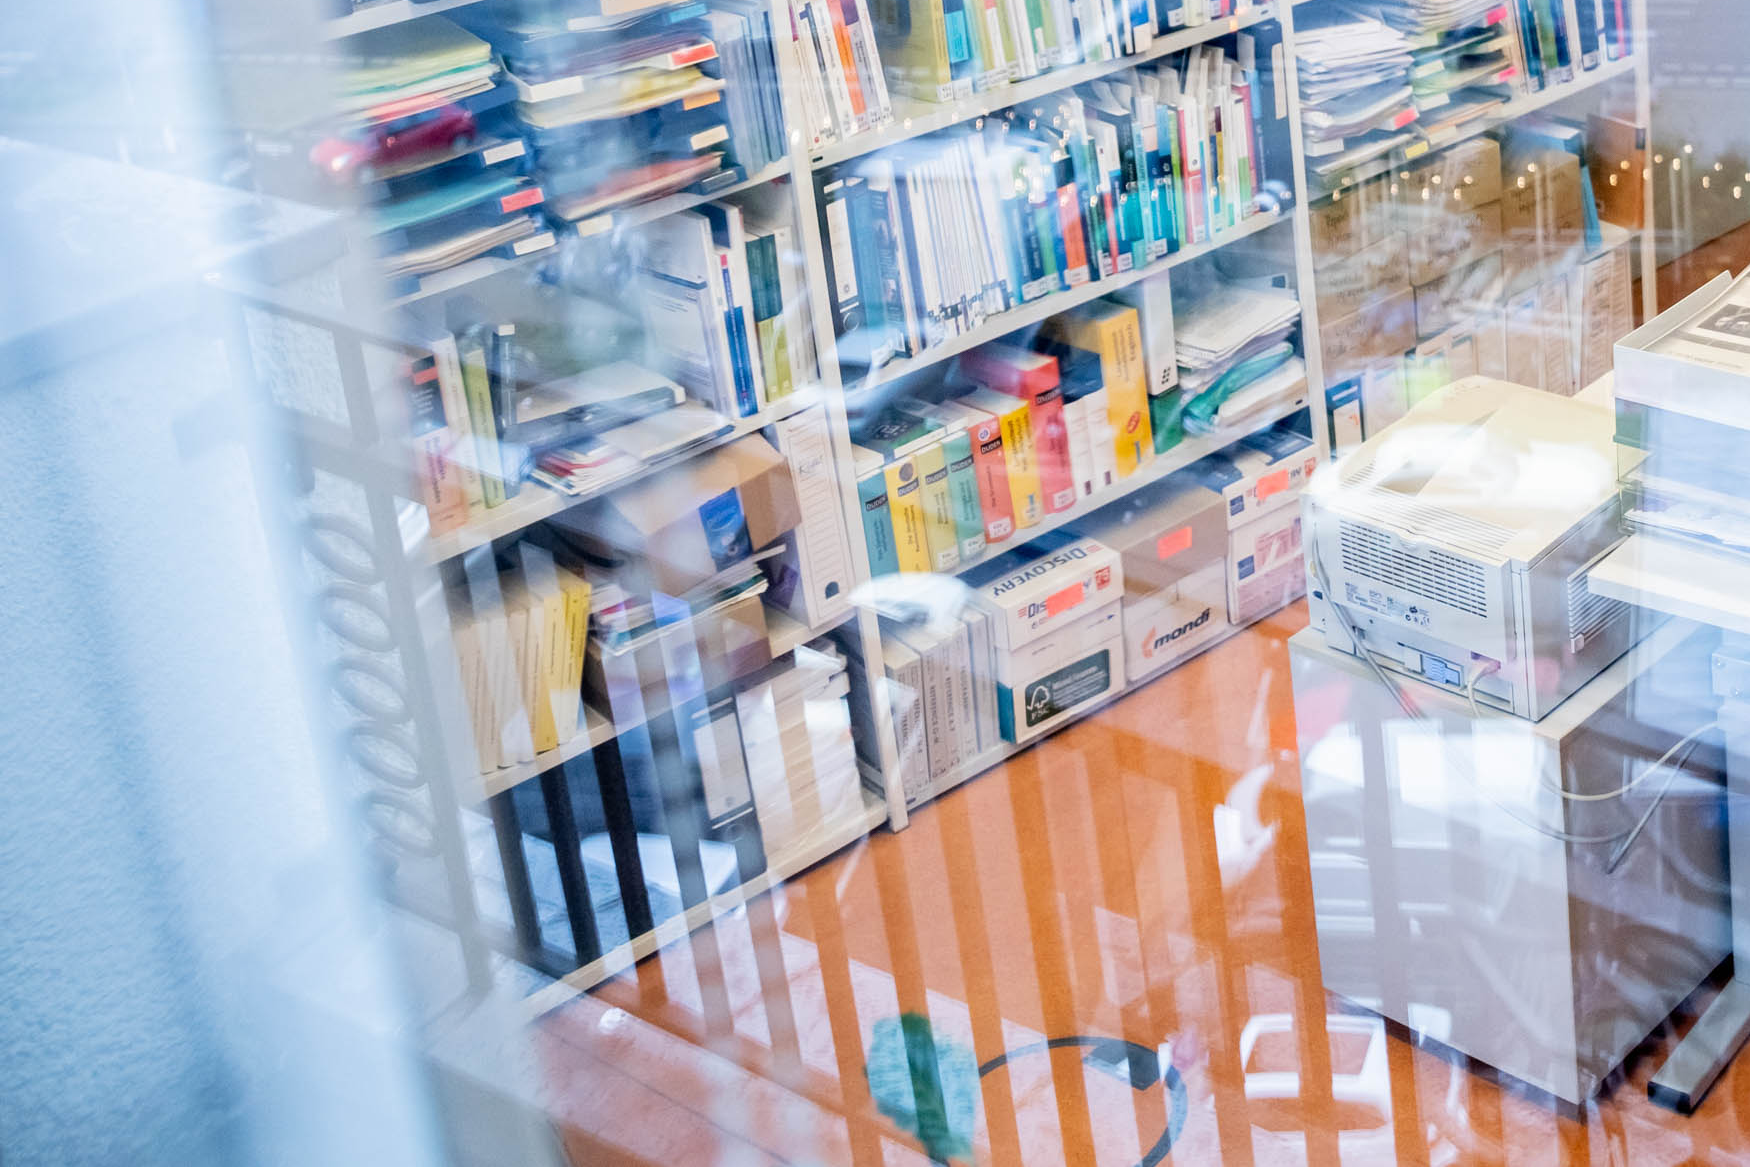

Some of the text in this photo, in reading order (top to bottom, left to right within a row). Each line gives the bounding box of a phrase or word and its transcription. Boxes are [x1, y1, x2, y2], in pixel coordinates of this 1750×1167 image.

[981, 439, 1001, 453] DUDEN
[951, 457, 973, 472] DUDEN
[866, 496, 887, 510] DUDEN
[993, 547, 1088, 597] DISCOVERY
[1153, 607, 1212, 650] mondi
